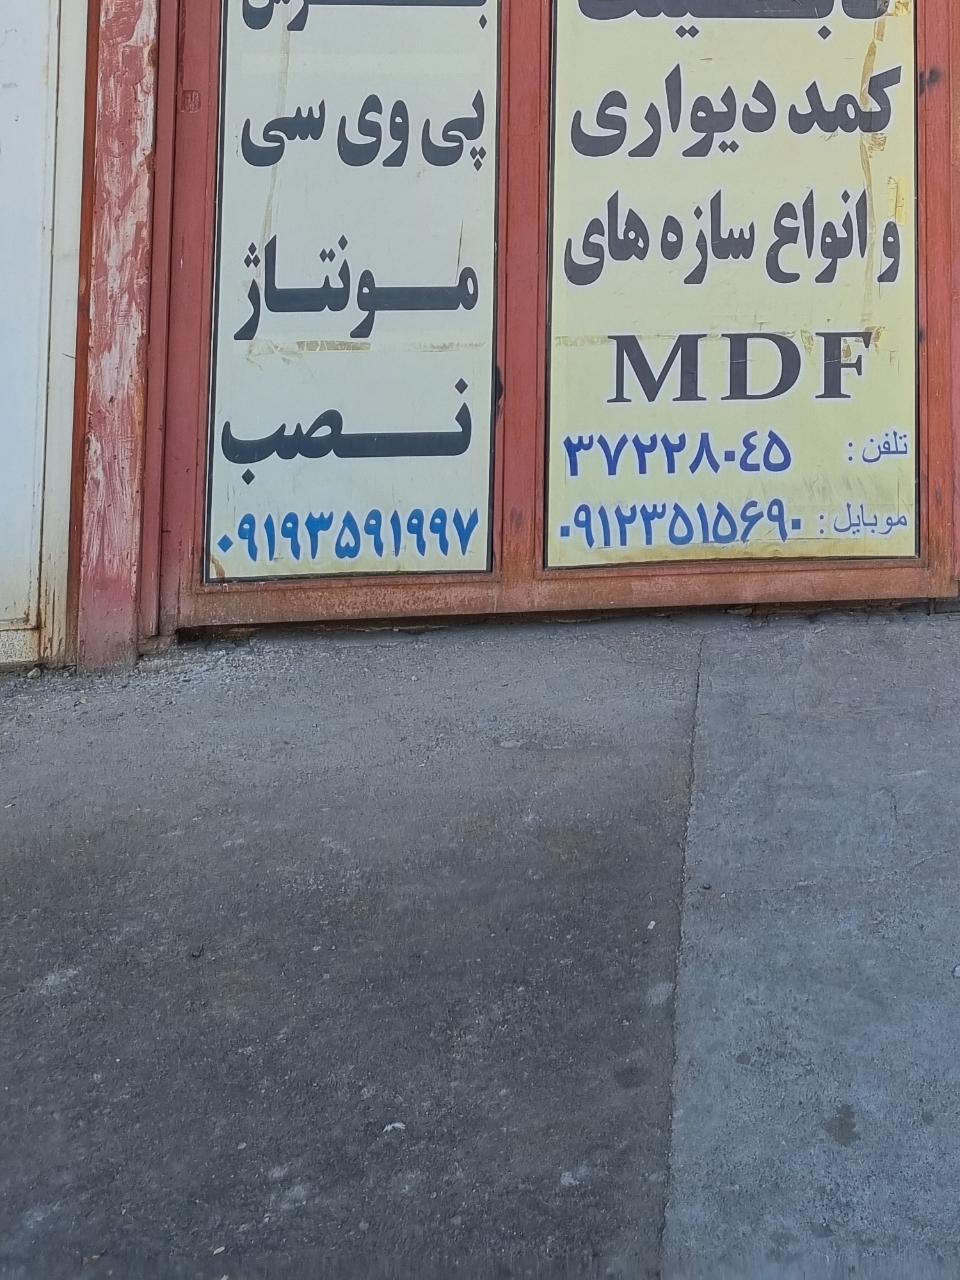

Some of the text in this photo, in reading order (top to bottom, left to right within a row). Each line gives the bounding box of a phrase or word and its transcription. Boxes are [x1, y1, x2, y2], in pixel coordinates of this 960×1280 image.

[241, 89, 487, 171] پی وی سی
[570, 64, 902, 157] کمد دیواری
[765, 189, 868, 283] انواع
[876, 221, 900, 283] و
[233, 234, 479, 340] مونتاژ
[606, 331, 872, 403] MDF
[221, 377, 472, 485] نصب
